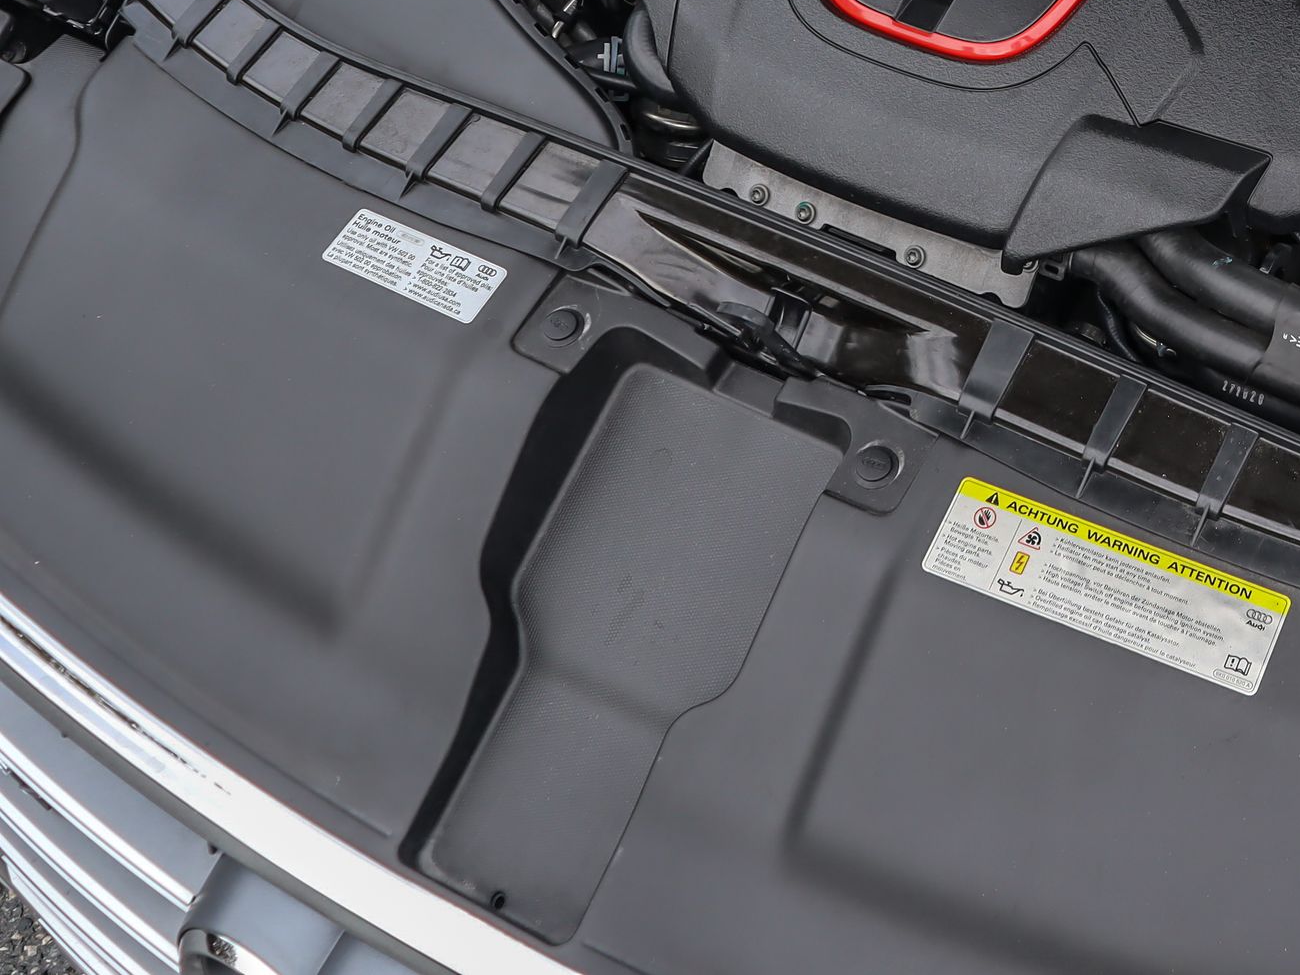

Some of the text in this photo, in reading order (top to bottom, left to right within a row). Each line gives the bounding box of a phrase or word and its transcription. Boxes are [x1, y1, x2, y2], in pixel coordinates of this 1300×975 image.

[351, 219, 373, 232] Huile
[370, 228, 402, 245] moteur
[355, 212, 397, 234] Engine Oil
[331, 245, 345, 254] avec
[343, 250, 355, 259] VW
[352, 254, 364, 263] 502
[362, 258, 372, 266] 00
[345, 227, 417, 261] Use only oil with VW 502 00
[364, 242, 380, 253] Most
[377, 249, 389, 257] are
[332, 254, 353, 267] plupart
[350, 262, 365, 271] sont
[335, 239, 413, 277] Utilisez uniquement des huiles
[424, 256, 437, 266] For
[437, 263, 449, 271] list
[446, 266, 456, 274] of
[453, 269, 482, 286] approved
[419, 262, 435, 272] Pour
[432, 268, 446, 277] une
[443, 272, 458, 283] liste
[474, 272, 490, 281] Audi
[948, 526, 975, 540] Bewegte
[952, 520, 970, 531] Heiße
[942, 538, 966, 552] Moving
[946, 533, 958, 541] Hot
[956, 537, 977, 550] engine
[1005, 498, 1253, 600] ACHTUNG WARNING ATTENTION
[934, 557, 954, 569] Pièces
[939, 546, 989, 569] Pièces du moteur
[1056, 543, 1081, 557] Radiator
[1080, 552, 1092, 561] fan
[1090, 557, 1105, 567] may
[1104, 561, 1119, 571] start
[1118, 566, 1126, 574] at
[1124, 570, 1136, 579] any
[1059, 537, 1105, 559] Kühlerventilator
[1104, 554, 1120, 564] kann
[1118, 559, 1144, 575] jederzeit
[1060, 552, 1093, 569] ventilateur
[1091, 564, 1106, 575] peut
[1113, 572, 1146, 589] déclencher
[1149, 586, 1163, 596] tout
[1041, 574, 1060, 586] Haute
[1082, 590, 1103, 603] arrêter
[1109, 601, 1131, 614] moteur
[1131, 609, 1149, 620] avant
[1147, 615, 1157, 624] de
[1156, 618, 1180, 632] toucher
[1044, 568, 1060, 580] High
[1083, 583, 1104, 596] Switch
[1103, 591, 1114, 599] off
[1111, 595, 1134, 608] engine
[1133, 602, 1153, 614] before
[1152, 609, 1179, 625] touching
[1092, 580, 1103, 588] vor
[1102, 583, 1131, 598] Berühren
[1130, 593, 1141, 602] der
[1140, 598, 1176, 617] Zündanlage
[1175, 611, 1194, 622] Motor
[1034, 594, 1063, 610] Overfilled
[1061, 605, 1084, 618] engine
[1082, 613, 1092, 621] oil
[1090, 617, 1103, 625] can
[1102, 620, 1127, 635] damage
[1037, 587, 1048, 596] Bei
[1046, 590, 1083, 610] Überfüllung
[1081, 604, 1105, 618] besteht
[1103, 613, 1125, 626] Gefahr
[1124, 621, 1134, 629] für
[1133, 625, 1147, 634] den
[1030, 600, 1069, 620] Remplissage
[1067, 614, 1093, 628] excessif
[1091, 623, 1113, 637] d'huile
[1111, 631, 1144, 649] dangereux
[1143, 644, 1159, 655] pour
[1158, 649, 1166, 657] le
[1244, 618, 1266, 632] Audi
